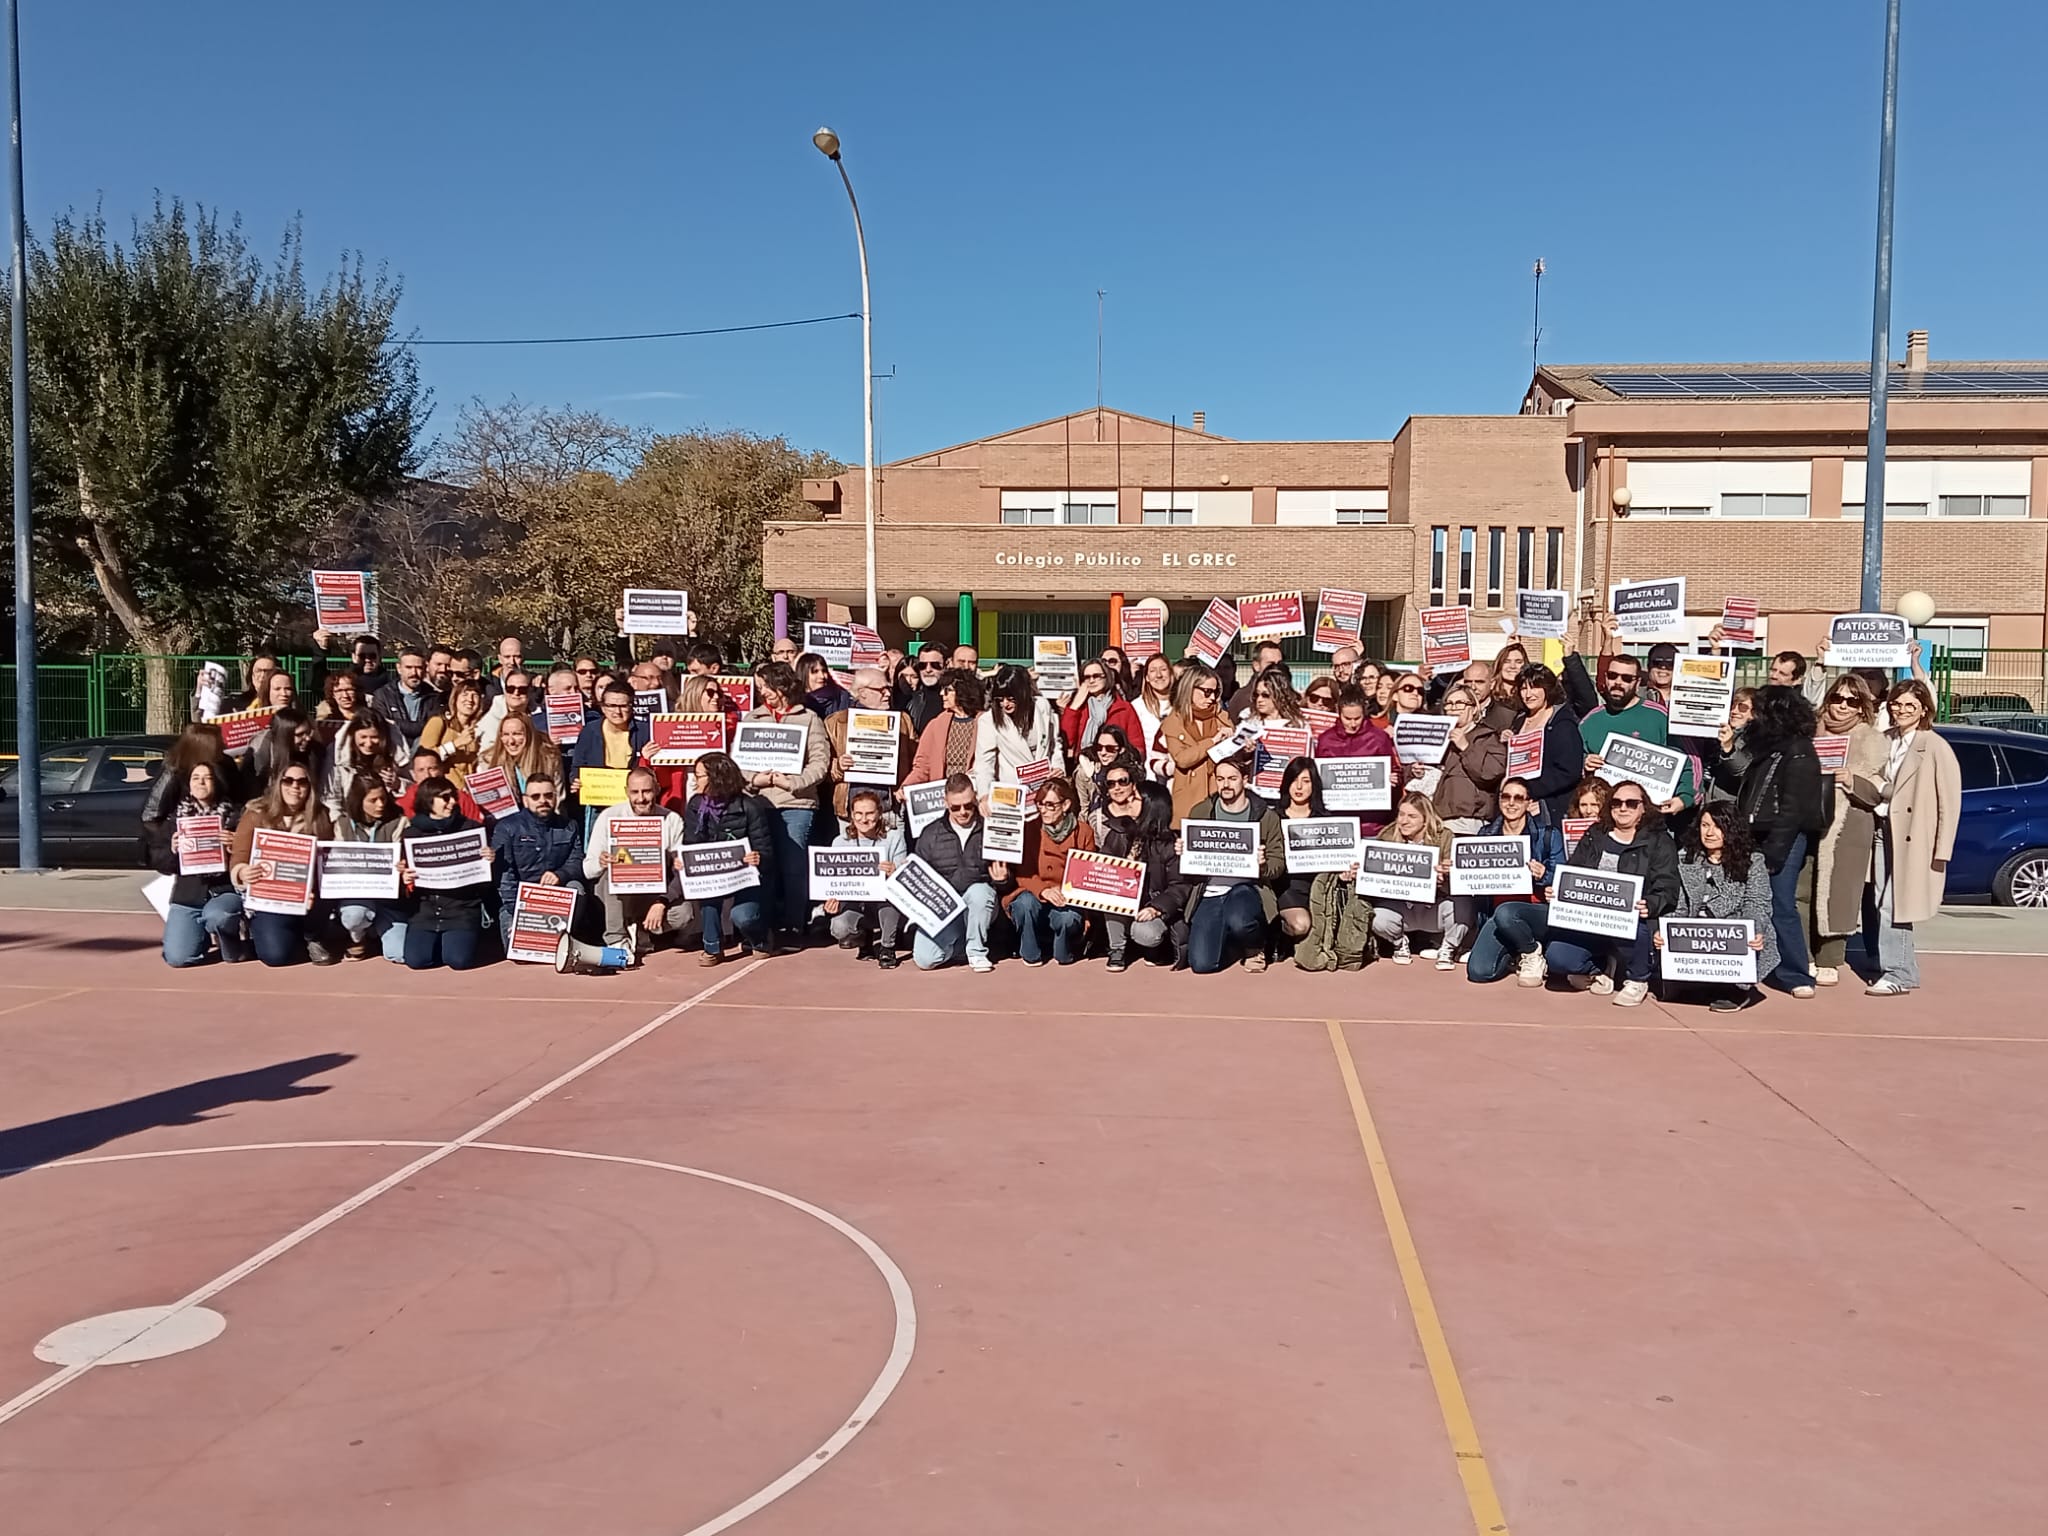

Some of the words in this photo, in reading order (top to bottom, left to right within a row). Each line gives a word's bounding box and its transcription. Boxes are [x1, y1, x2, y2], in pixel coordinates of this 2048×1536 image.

[995, 552, 1064, 568] Colegio
[1075, 552, 1142, 566] Público
[1162, 553, 1181, 566] EL
[1188, 553, 1237, 566] GREC
[316, 574, 324, 584] 7
[1324, 592, 1330, 600] 7
[1628, 590, 1652, 599] BASTA
[1654, 588, 1665, 596] DE
[1619, 599, 1672, 610] SOBRECARGA
[1423, 614, 1430, 622] 7
[1837, 622, 1875, 630] RATIOS
[1879, 620, 1901, 630] MÉS
[812, 628, 839, 637] RATIOS
[1851, 632, 1889, 641] BAIXES
[825, 637, 847, 646] BAJAS
[639, 696, 658, 705] MÉS
[754, 731, 775, 739] PROU
[741, 740, 798, 750] SOBRECÀRREGA
[1612, 743, 1650, 761] RATIOS
[1650, 755, 1674, 769] MÁS
[1625, 759, 1656, 775] BAJAS
[914, 789, 945, 802] RATIOS
[612, 822, 620, 832] 7
[1302, 827, 1326, 835] PROU
[1328, 826, 1340, 834] DE
[1200, 830, 1227, 838] BASTA
[258, 834, 268, 845] 7
[1290, 837, 1354, 847] SOBRECÀRREGA
[1192, 841, 1248, 851] SOBRECARGA
[1458, 846, 1468, 854] EL
[1470, 843, 1519, 854] VALENCIÀ
[695, 853, 720, 861] BASTA
[816, 854, 826, 863] EL
[828, 853, 875, 863] VALENCIÀ
[1368, 850, 1404, 862] RATIOS
[1406, 853, 1430, 865] MÁS
[689, 861, 743, 873] SOBRECARGA
[1479, 859, 1489, 867] ES
[1491, 858, 1519, 866] TOCA
[820, 867, 834, 875] NO
[837, 867, 848, 875] ES
[848, 867, 875, 875] TOCA
[1384, 862, 1414, 874] BAJAS
[1392, 880, 1422, 888] ESCUELA
[1575, 879, 1605, 891] BASTA
[1606, 884, 1620, 893] DE
[523, 888, 532, 898] 7
[1380, 888, 1410, 896] CALIDAD
[1563, 890, 1626, 907] SOBRECARGA
[1574, 909, 1593, 918] FALTA
[1603, 914, 1634, 924] PERSONAL
[1556, 914, 1582, 924] DOCENTE
[1601, 921, 1628, 931] DOCENTE
[1671, 927, 1713, 938] RATIOS
[1716, 926, 1743, 939] MÁS
[1691, 940, 1727, 952] BAJAS
